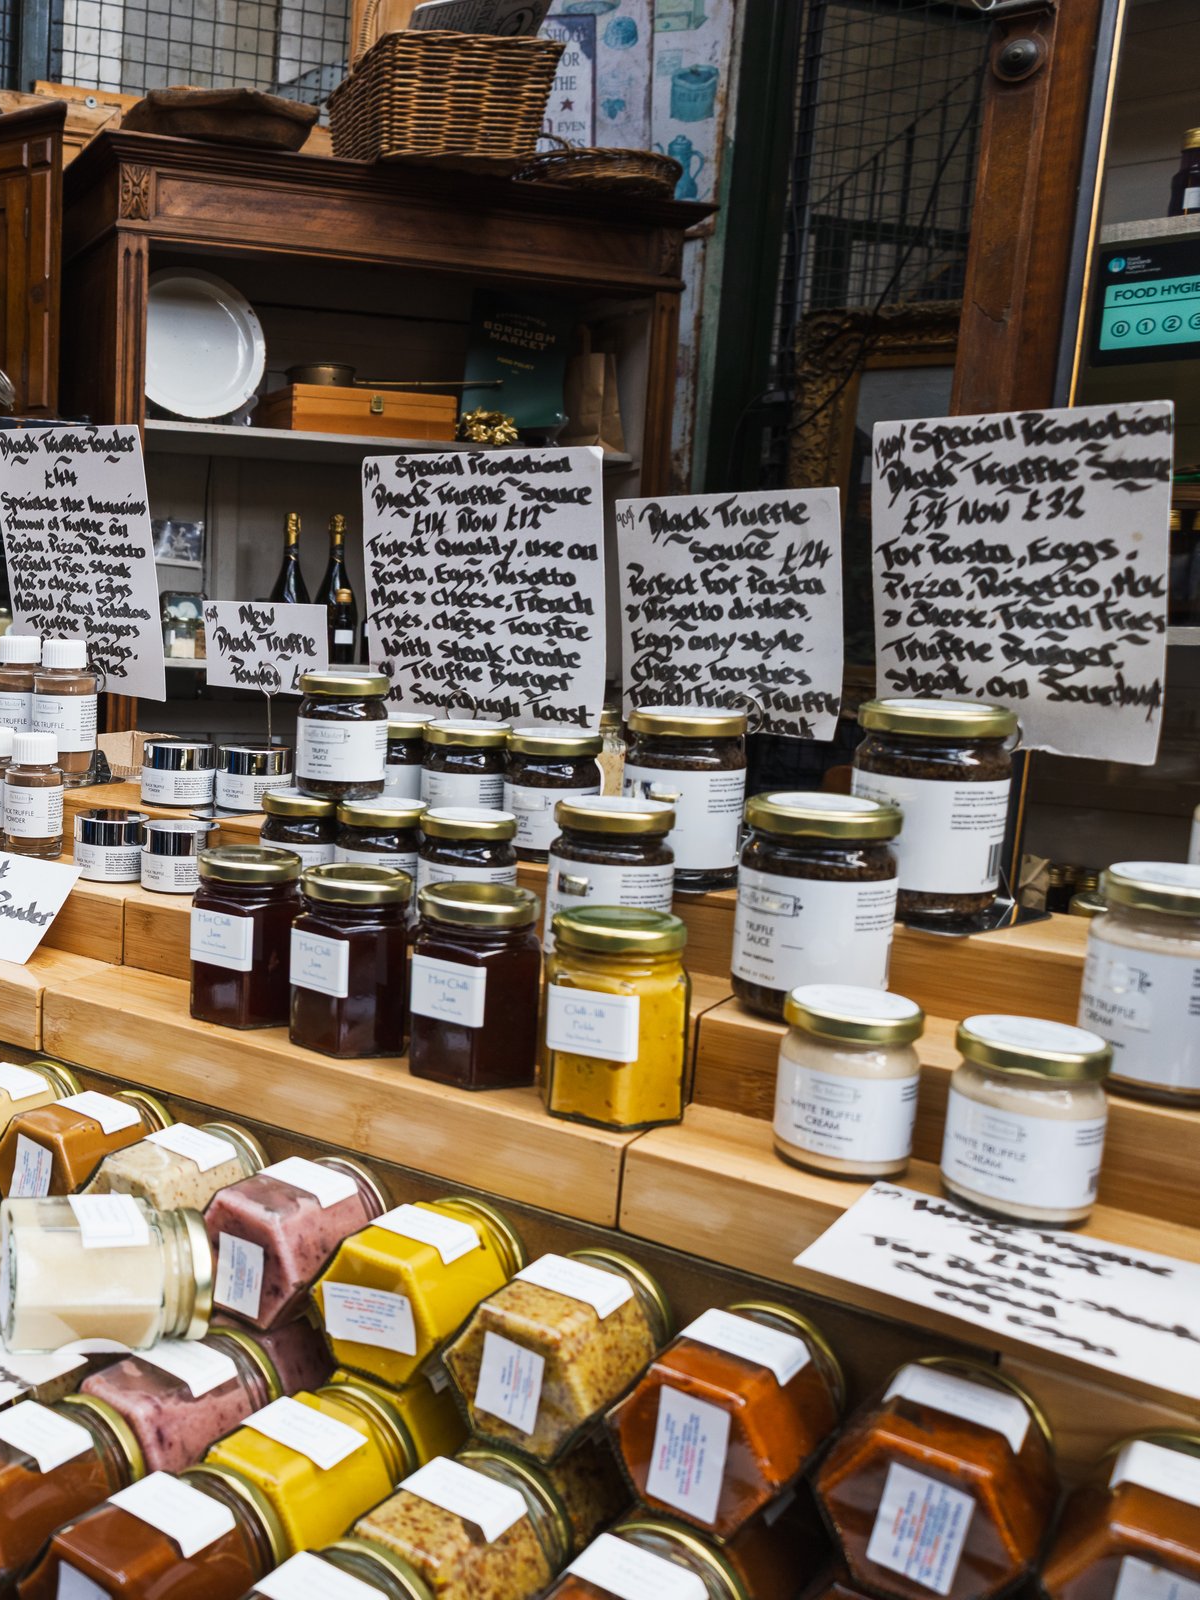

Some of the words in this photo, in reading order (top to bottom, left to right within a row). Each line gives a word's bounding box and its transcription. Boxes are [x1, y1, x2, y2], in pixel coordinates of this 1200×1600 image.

[559, 52, 580, 66] OR
[558, 121, 585, 131] EVEN
[1114, 287, 1158, 301] FOOD
[483, 320, 556, 343] BOROUGH
[489, 331, 548, 351] MARKET
[38, 429, 88, 454] Truffle
[85, 427, 136, 453] Powder
[910, 416, 1017, 457] Special
[1016, 409, 1172, 447] Promotion
[45, 467, 78, 490] £44
[394, 454, 465, 482] Special
[468, 452, 572, 476] Promotion
[880, 452, 967, 508] Black
[960, 451, 1080, 486] Truffle
[372, 479, 432, 516] Black
[430, 481, 507, 506] Truffle
[518, 484, 592, 506] Sauce
[1021, 485, 1086, 522] £32
[60, 515, 105, 537] Truffle
[639, 501, 710, 543] Black
[712, 494, 810, 529] Truffle
[85, 536, 146, 559] Risotto
[366, 531, 430, 558] Finest
[566, 542, 598, 561] on
[688, 540, 775, 564] Sauce
[778, 539, 833, 577] £24
[875, 535, 925, 569] For
[89, 560, 131, 579] Steak
[488, 563, 577, 587] Risotto
[626, 562, 699, 596] Perfect
[746, 565, 827, 596] Pasta
[510, 586, 596, 616] French
[641, 598, 725, 624] Risotto
[25, 613, 80, 632] Truffle
[238, 604, 275, 626] New
[432, 610, 496, 636] Cheese
[500, 614, 592, 642] Toastie
[992, 599, 1093, 632] French
[212, 626, 256, 656] Black
[257, 631, 317, 656] Truffle
[630, 627, 685, 658] Eggs
[687, 632, 738, 658] any
[881, 630, 994, 664] Truffle
[510, 641, 582, 669] Create
[228, 655, 281, 686] Powder
[400, 659, 484, 684] Truffle
[489, 665, 575, 694] Burger
[630, 656, 702, 683] Cheese
[705, 654, 813, 686] Toasties
[3, 717, 28, 725] TRUFFLE
[523, 695, 596, 728] Toast
[43, 721, 65, 729] TRUFFLE
[14, 809, 34, 817] TRUFFLE
[745, 920, 774, 937] TRUFFLE
[746, 932, 771, 948] SAUCE
[1084, 1009, 1114, 1027] CREAM
[1096, 999, 1136, 1020] TRUFFLE
[804, 1114, 841, 1132] CREAM
[820, 1105, 863, 1123] TRUFFLE
[964, 1150, 1003, 1170] CREAM
[981, 1139, 1027, 1162] TRUFFLE
